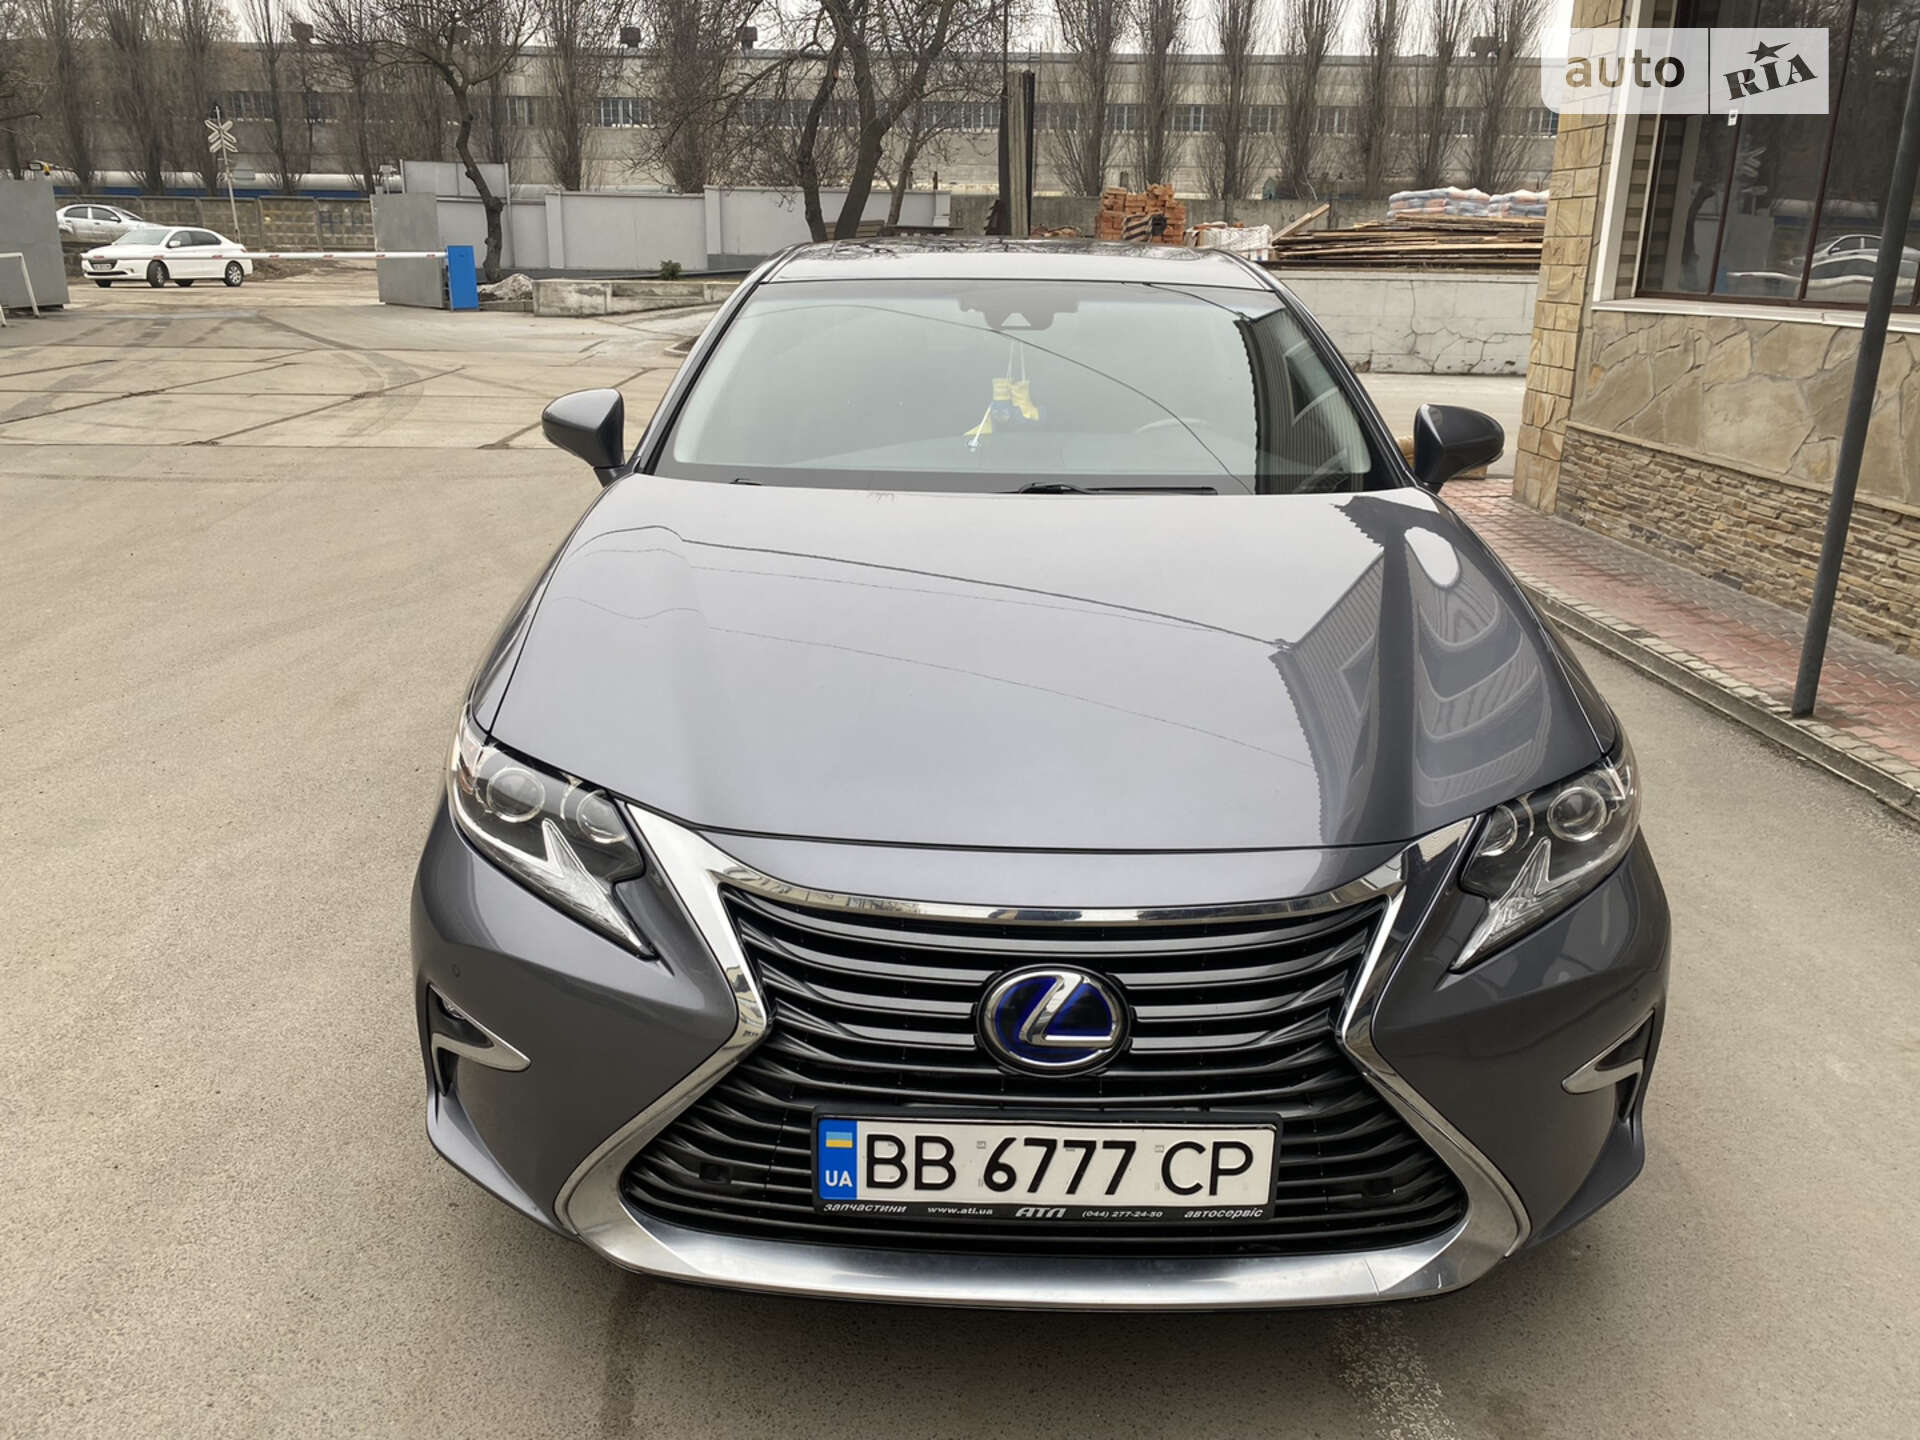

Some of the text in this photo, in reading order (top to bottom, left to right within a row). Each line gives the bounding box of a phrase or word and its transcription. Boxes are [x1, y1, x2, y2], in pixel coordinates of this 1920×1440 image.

[865, 1133, 1255, 1197] BB 6777 CP
[825, 1170, 853, 1188] UA
[823, 1203, 907, 1213] запчастини
[1184, 1207, 1264, 1220] автосервіс
